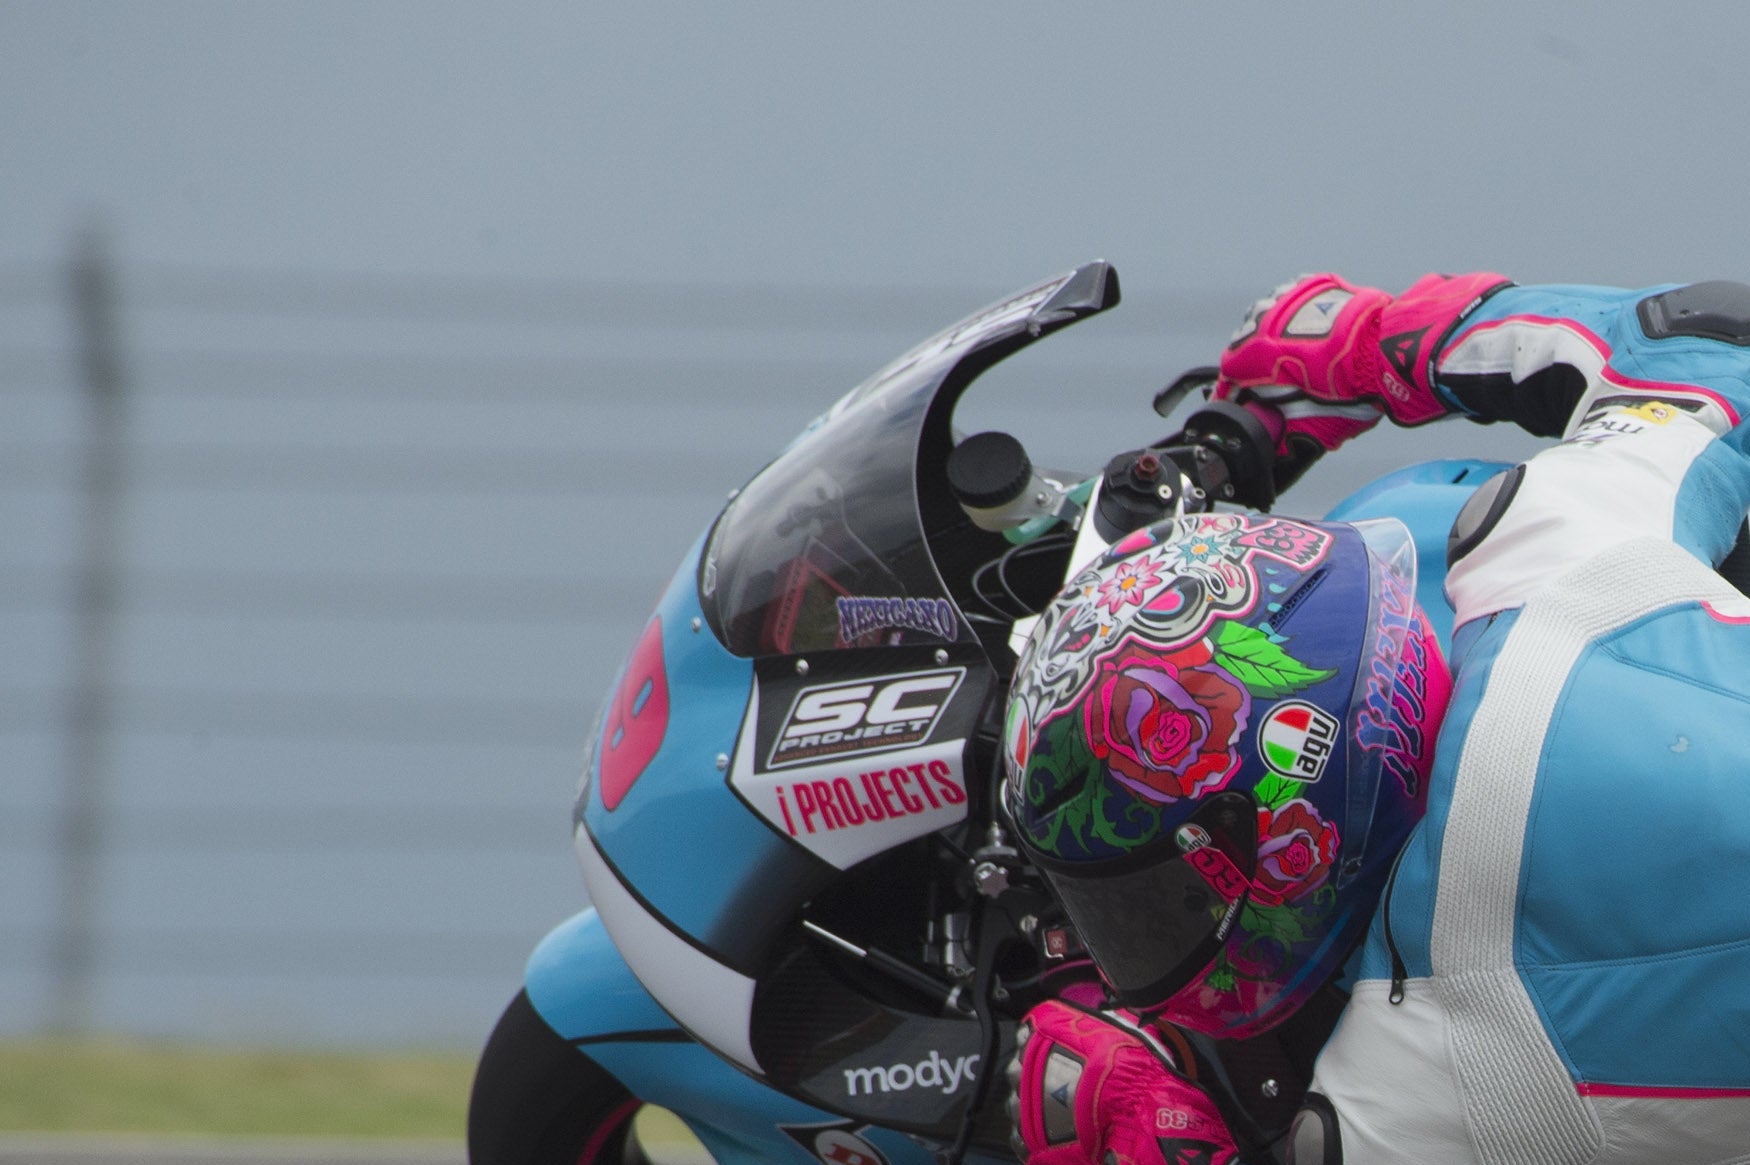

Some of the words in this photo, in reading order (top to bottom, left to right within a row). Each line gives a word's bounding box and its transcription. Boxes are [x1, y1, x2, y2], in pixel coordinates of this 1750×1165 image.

[779, 718, 930, 752] PROJECT
[787, 675, 955, 738] SC
[1299, 717, 1338, 776] agv
[796, 759, 967, 834] PROJECTS
